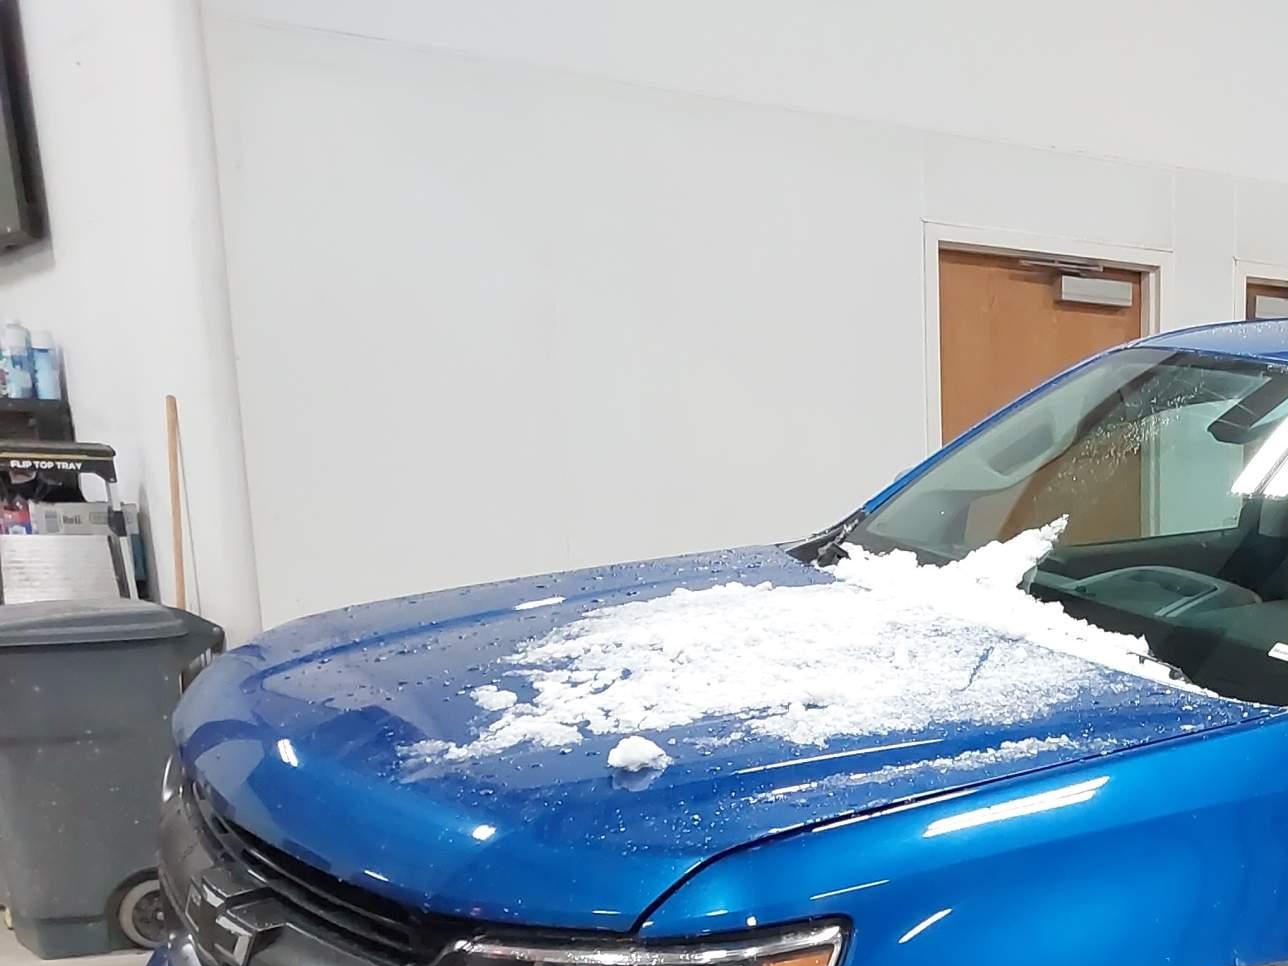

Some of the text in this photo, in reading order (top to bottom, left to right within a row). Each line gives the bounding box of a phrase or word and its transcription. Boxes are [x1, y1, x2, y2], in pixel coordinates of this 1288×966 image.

[10, 460, 82, 470] FLIP TOP TRAY
